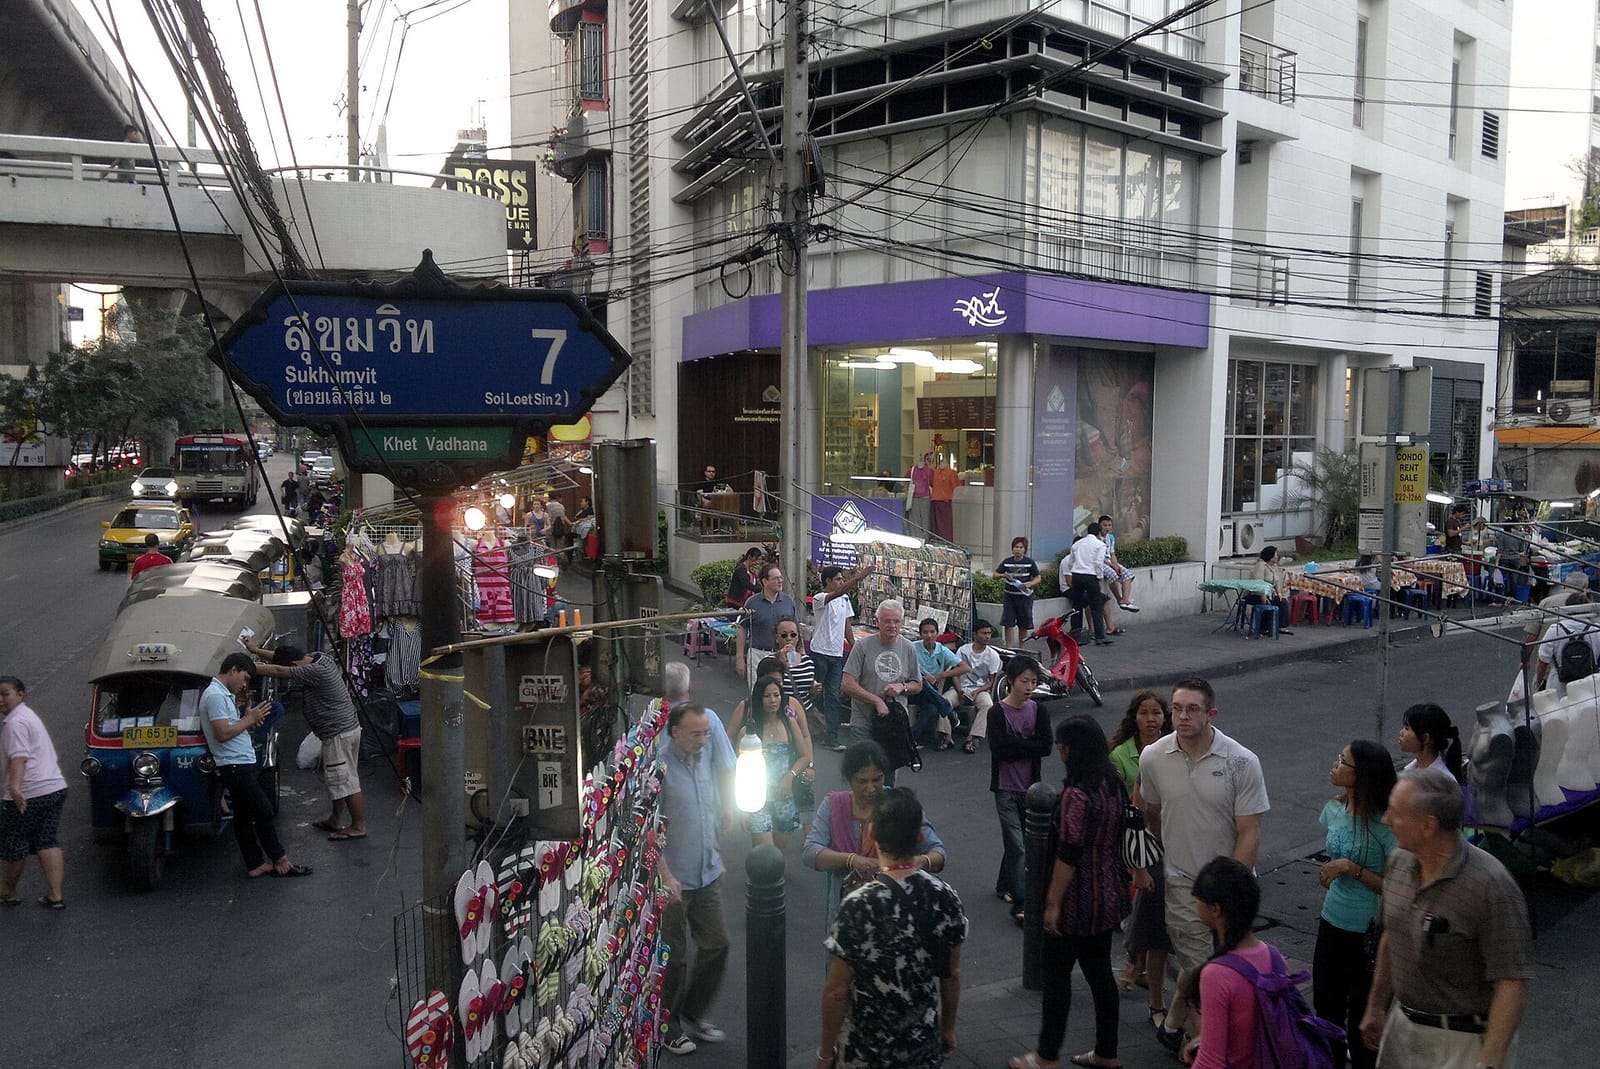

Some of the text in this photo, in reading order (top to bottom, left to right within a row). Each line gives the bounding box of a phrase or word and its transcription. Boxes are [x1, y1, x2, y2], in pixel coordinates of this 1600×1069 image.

[284, 303, 433, 364] สุขุมวิท
[532, 329, 567, 385] 7
[285, 366, 376, 384] Sukhumvit
[485, 391, 504, 405] Soi
[506, 391, 532, 405] Loet
[534, 391, 553, 405] Sin
[383, 437, 488, 451] Khet Vadhana
[1396, 453, 1423, 461] CONDO
[1399, 464, 1419, 472] RENT
[1399, 474, 1418, 482] SALE
[1402, 484, 1414, 493] 083
[138, 646, 168, 654] TAXI
[524, 678, 562, 701] NE
[147, 727, 175, 738] 6515
[525, 728, 564, 750] BNE
[543, 774, 558, 788] BNE
[548, 790, 553, 804] 1
